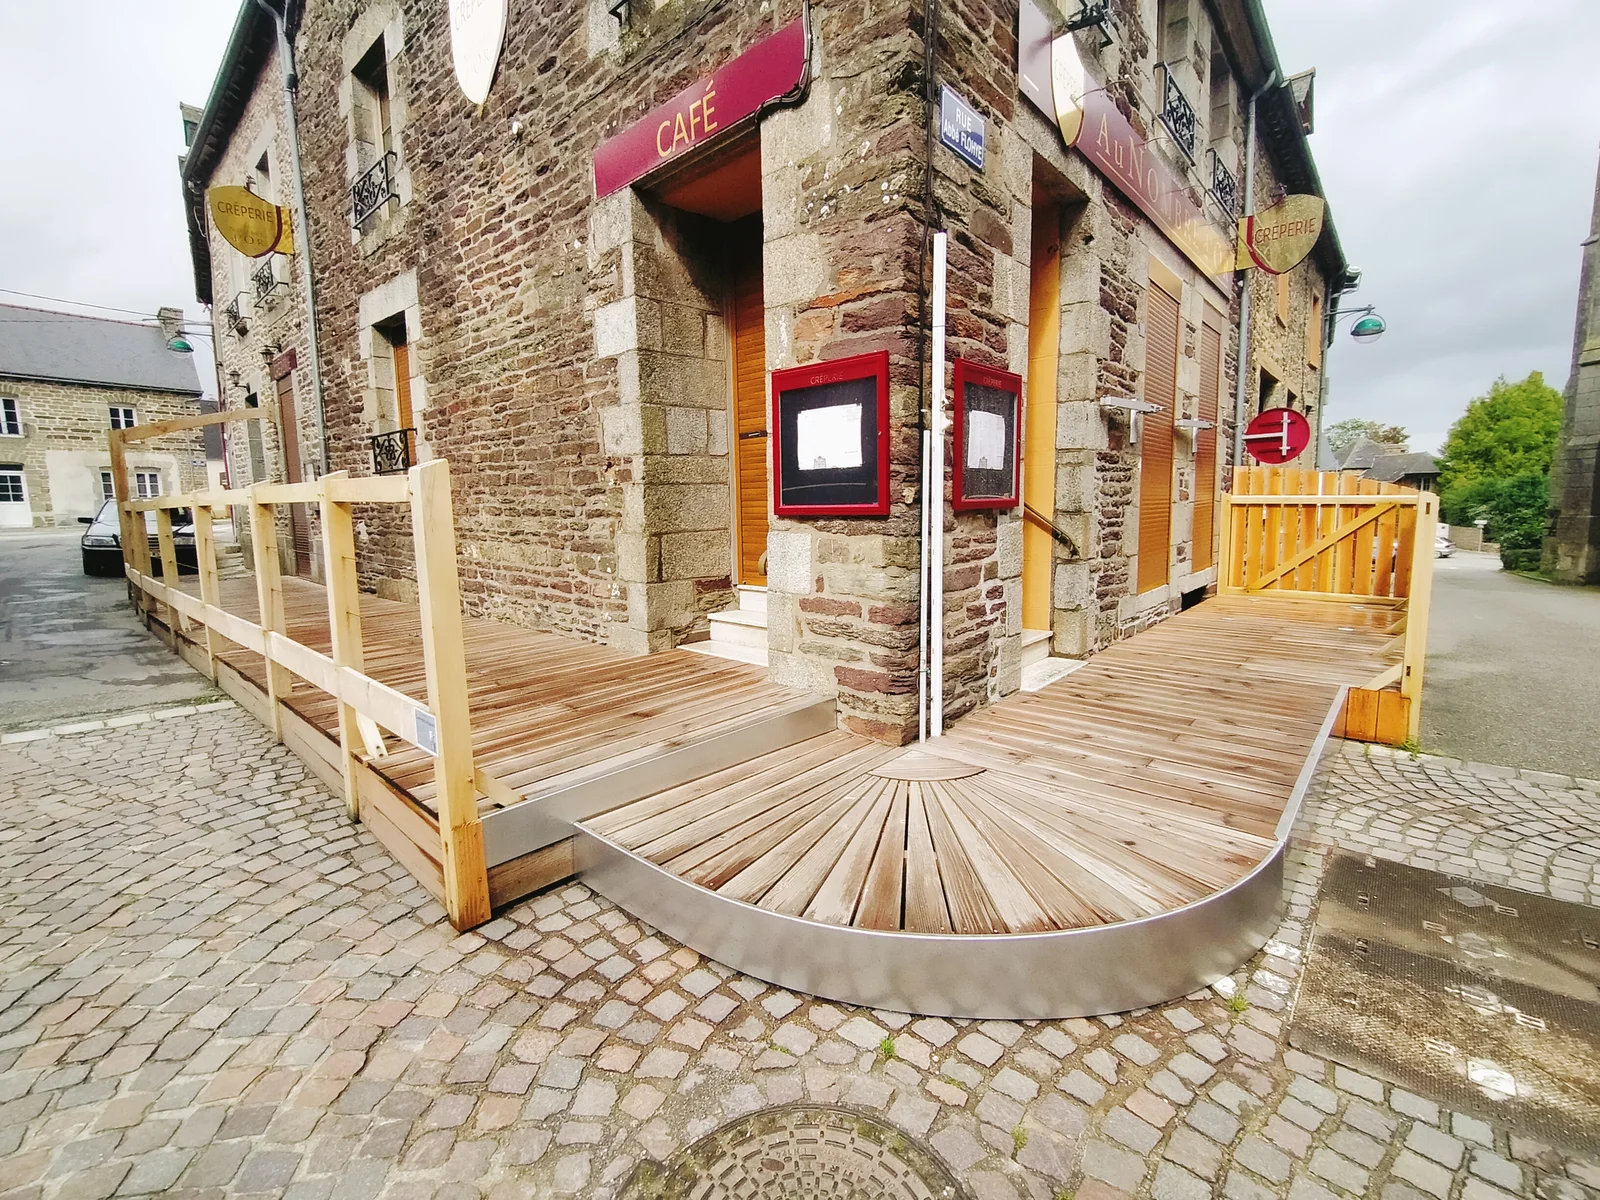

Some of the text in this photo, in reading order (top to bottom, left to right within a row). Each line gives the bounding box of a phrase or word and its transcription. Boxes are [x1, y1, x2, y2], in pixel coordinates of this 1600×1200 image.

[656, 79, 718, 158] CAFÉ
[943, 118, 959, 143] Abbé
[955, 107, 972, 133] RUE
[1254, 217, 1317, 244] CRÊPERIE
